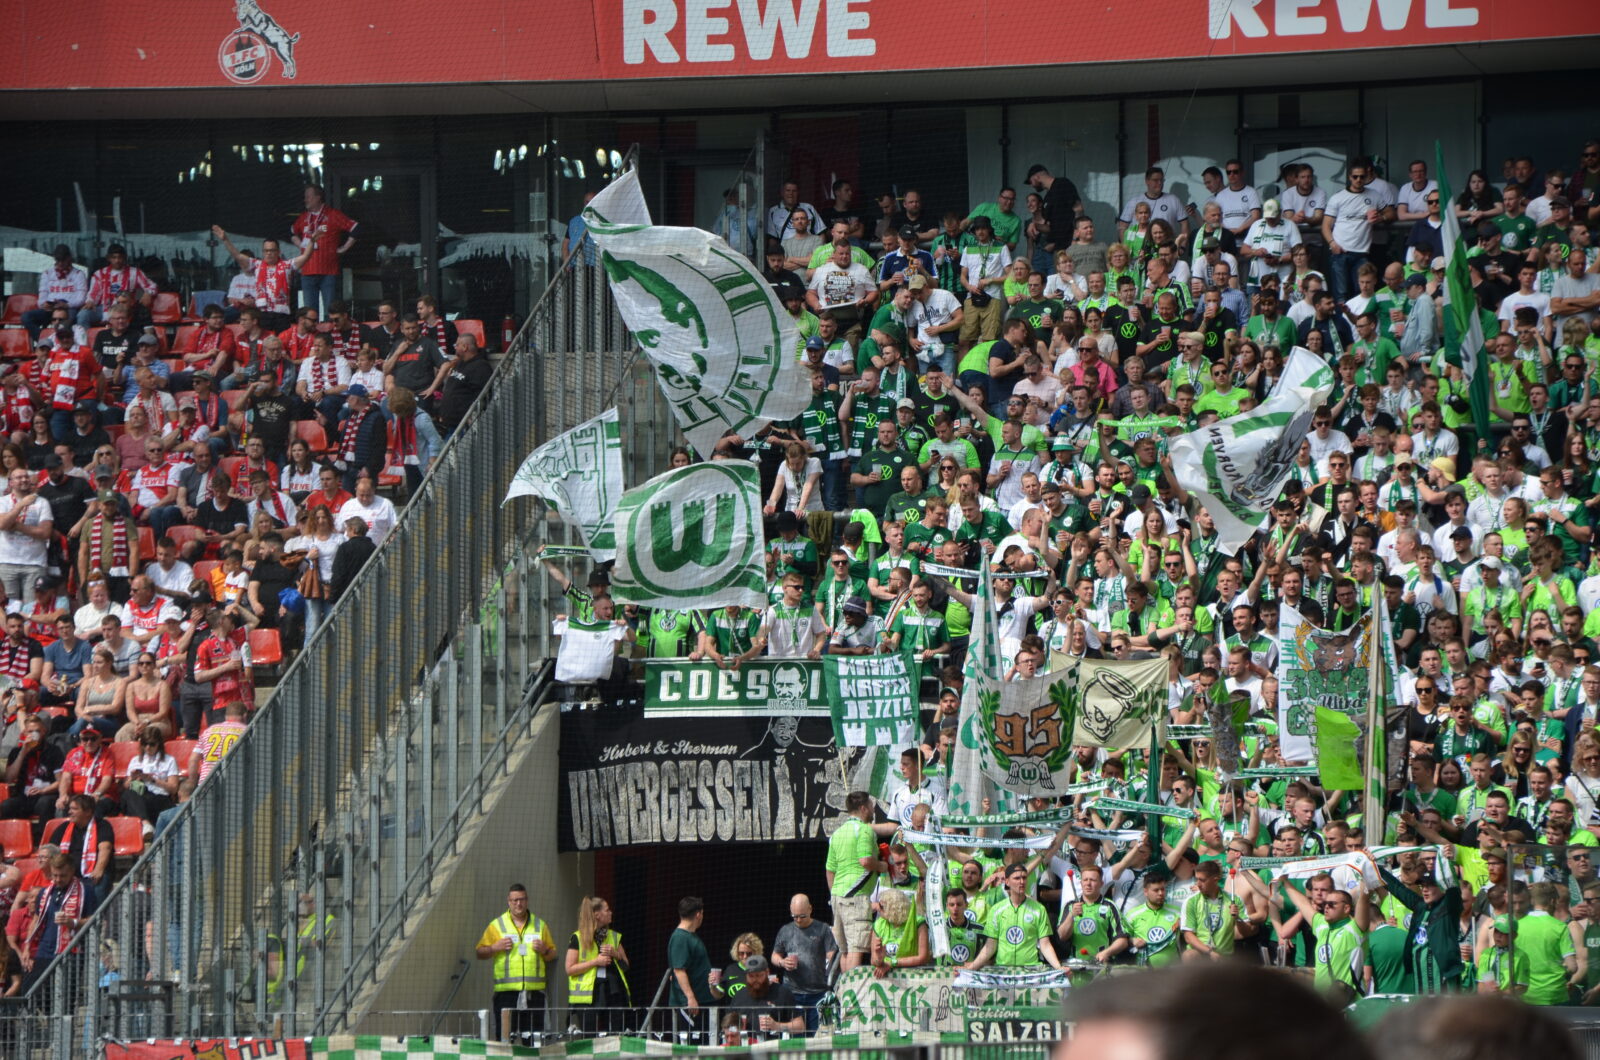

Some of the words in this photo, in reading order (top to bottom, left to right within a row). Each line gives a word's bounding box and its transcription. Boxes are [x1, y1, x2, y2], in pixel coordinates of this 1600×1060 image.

[623, 0, 876, 64] REWE
[140, 477, 165, 486] REWE
[290, 483, 311, 491] REWE
[994, 701, 1062, 758] 95
[599, 741, 651, 762] Hubert
[653, 740, 669, 755] &
[671, 740, 738, 756] Sherman
[568, 759, 771, 850] UNVERGESSEN
[976, 808, 1055, 823] WOLFSBURG
[966, 1006, 1021, 1019] Sektion
